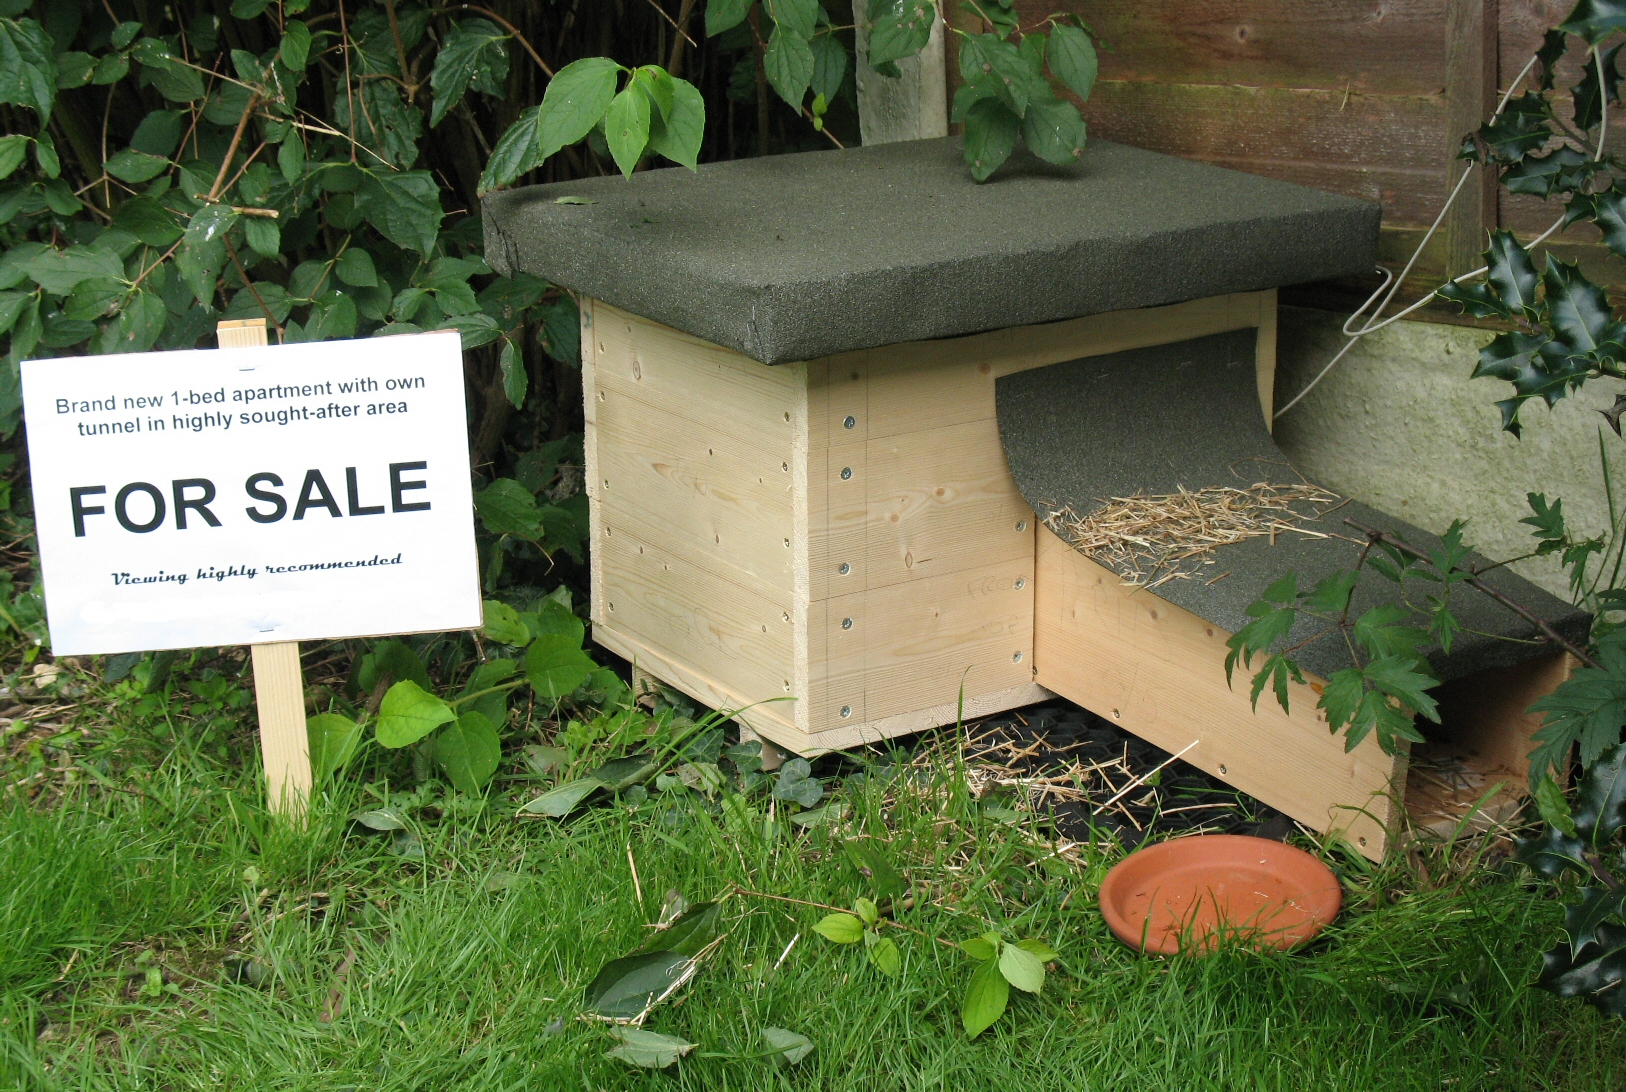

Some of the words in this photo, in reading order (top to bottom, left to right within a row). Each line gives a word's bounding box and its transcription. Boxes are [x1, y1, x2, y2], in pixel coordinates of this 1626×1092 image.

[56, 396, 115, 414] Brand
[124, 396, 163, 409] new
[171, 388, 225, 405] 1-bed
[233, 381, 332, 404] apartment
[338, 377, 377, 393] with
[386, 377, 425, 390] own
[78, 418, 140, 436] tunnel
[148, 416, 165, 431] in
[173, 412, 232, 432] highly
[240, 403, 360, 425] sought-after
[367, 402, 407, 415] area
[70, 478, 222, 537] FOR
[245, 461, 431, 523] SALE
[112, 571, 188, 585] Viewing
[197, 565, 258, 581] highly
[266, 553, 402, 573] recommended
